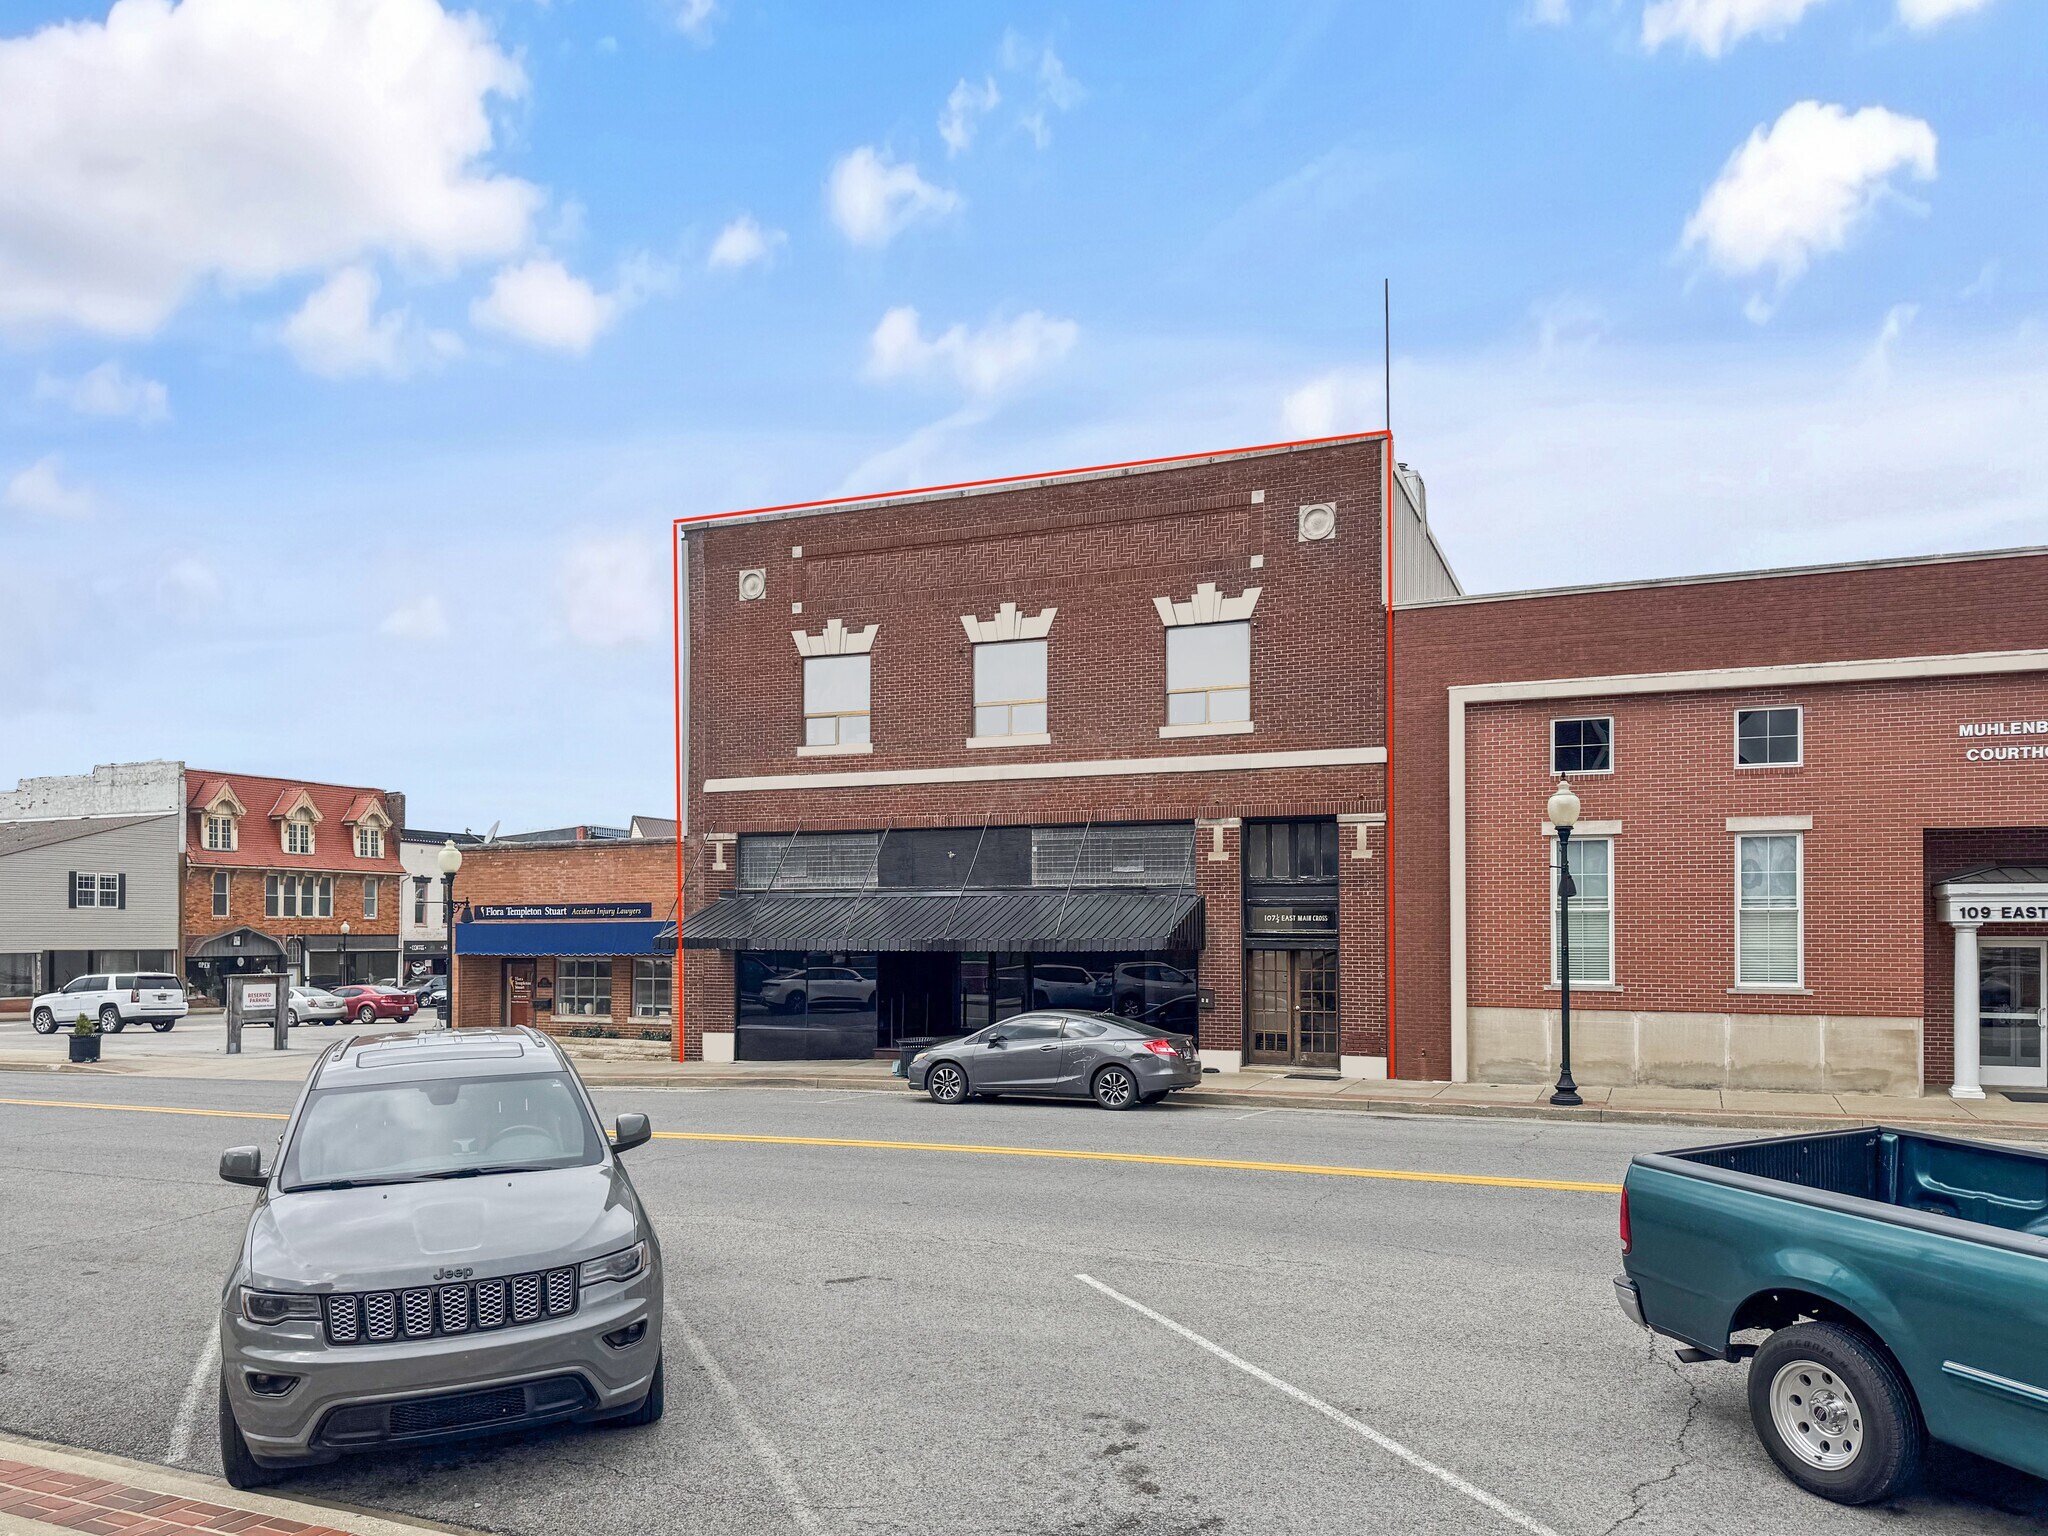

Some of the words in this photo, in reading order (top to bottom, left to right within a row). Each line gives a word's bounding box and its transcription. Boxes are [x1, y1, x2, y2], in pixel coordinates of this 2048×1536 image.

[1959, 721, 2048, 736] MUHLENB
[1966, 746, 2048, 761] COURTH
[486, 906, 504, 916] Flora
[506, 906, 542, 918] Templeton
[544, 906, 568, 916] Stuart
[571, 907, 596, 916] Accident
[596, 907, 616, 917] Injury
[616, 906, 642, 917] Lawyers
[1281, 914, 1296, 922] EAST
[1297, 914, 1312, 922] MAIN
[1312, 914, 1328, 922] CROSS
[1959, 906, 1992, 919] 109
[2001, 906, 2048, 919] EAST
[433, 1266, 474, 1281] Jeep
